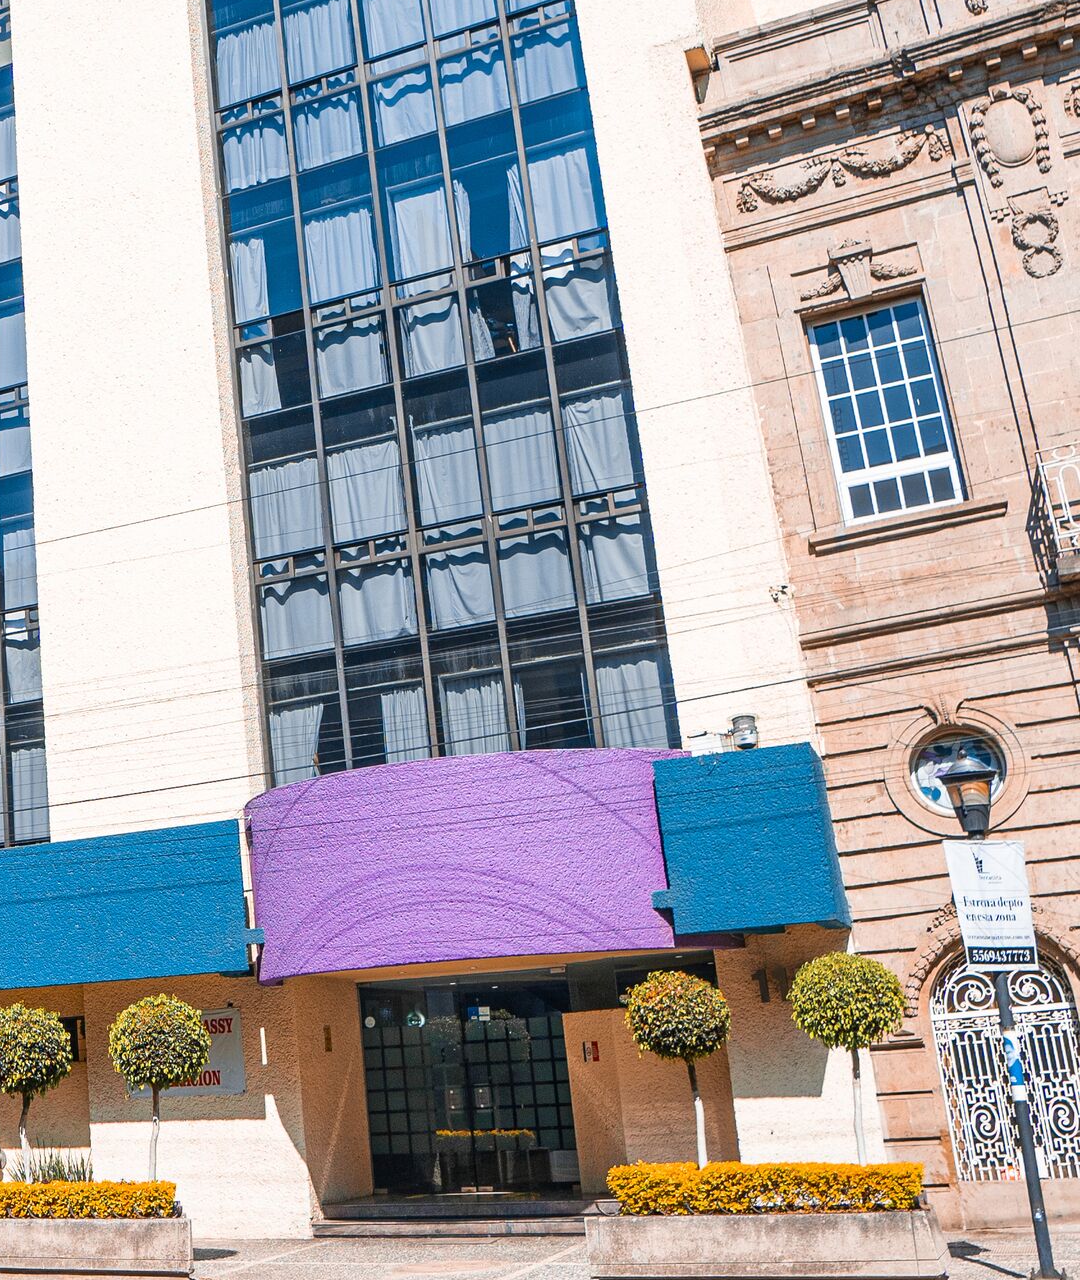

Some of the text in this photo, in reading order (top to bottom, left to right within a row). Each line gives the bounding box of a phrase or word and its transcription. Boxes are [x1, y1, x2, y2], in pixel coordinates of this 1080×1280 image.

[998, 896, 1024, 911] depto
[995, 913, 1017, 921] zona
[972, 949, 1031, 962] 5569437773
